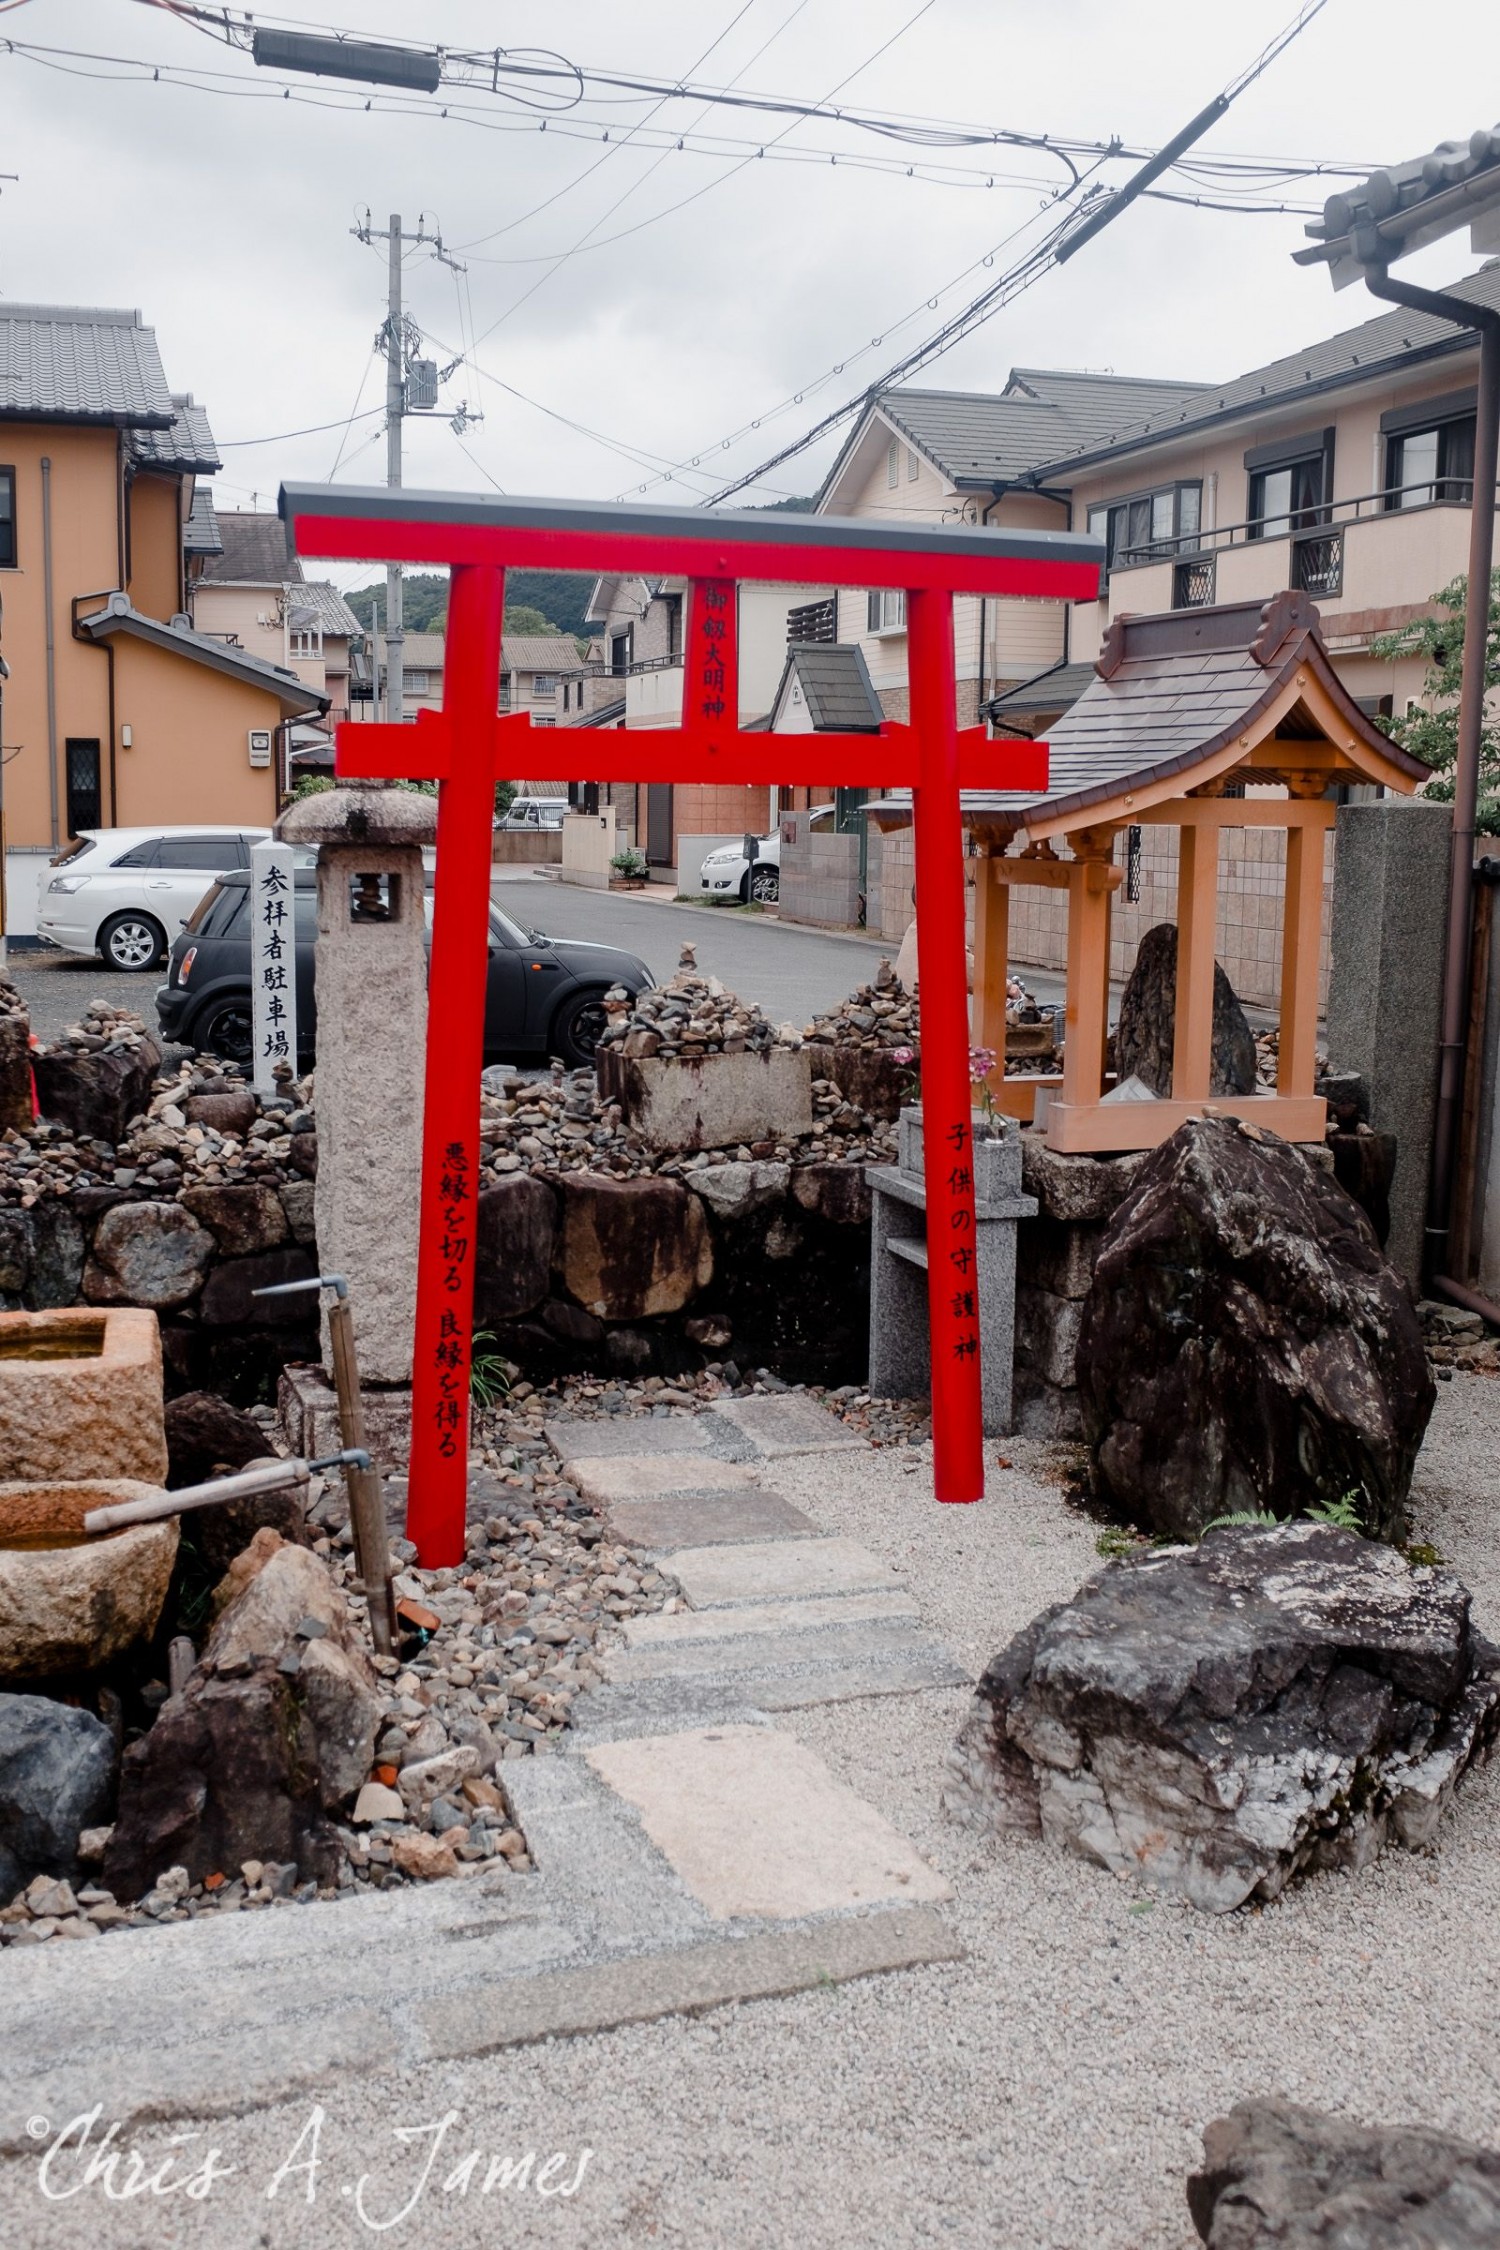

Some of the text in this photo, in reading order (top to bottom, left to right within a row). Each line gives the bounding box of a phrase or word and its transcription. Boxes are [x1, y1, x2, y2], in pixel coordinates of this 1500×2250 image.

[260, 864, 290, 1058] 参拝者駐車場
[433, 1141, 470, 1458] 悪縁を切る 良縁を得る
[946, 1122, 978, 1363] 子供の守護神
